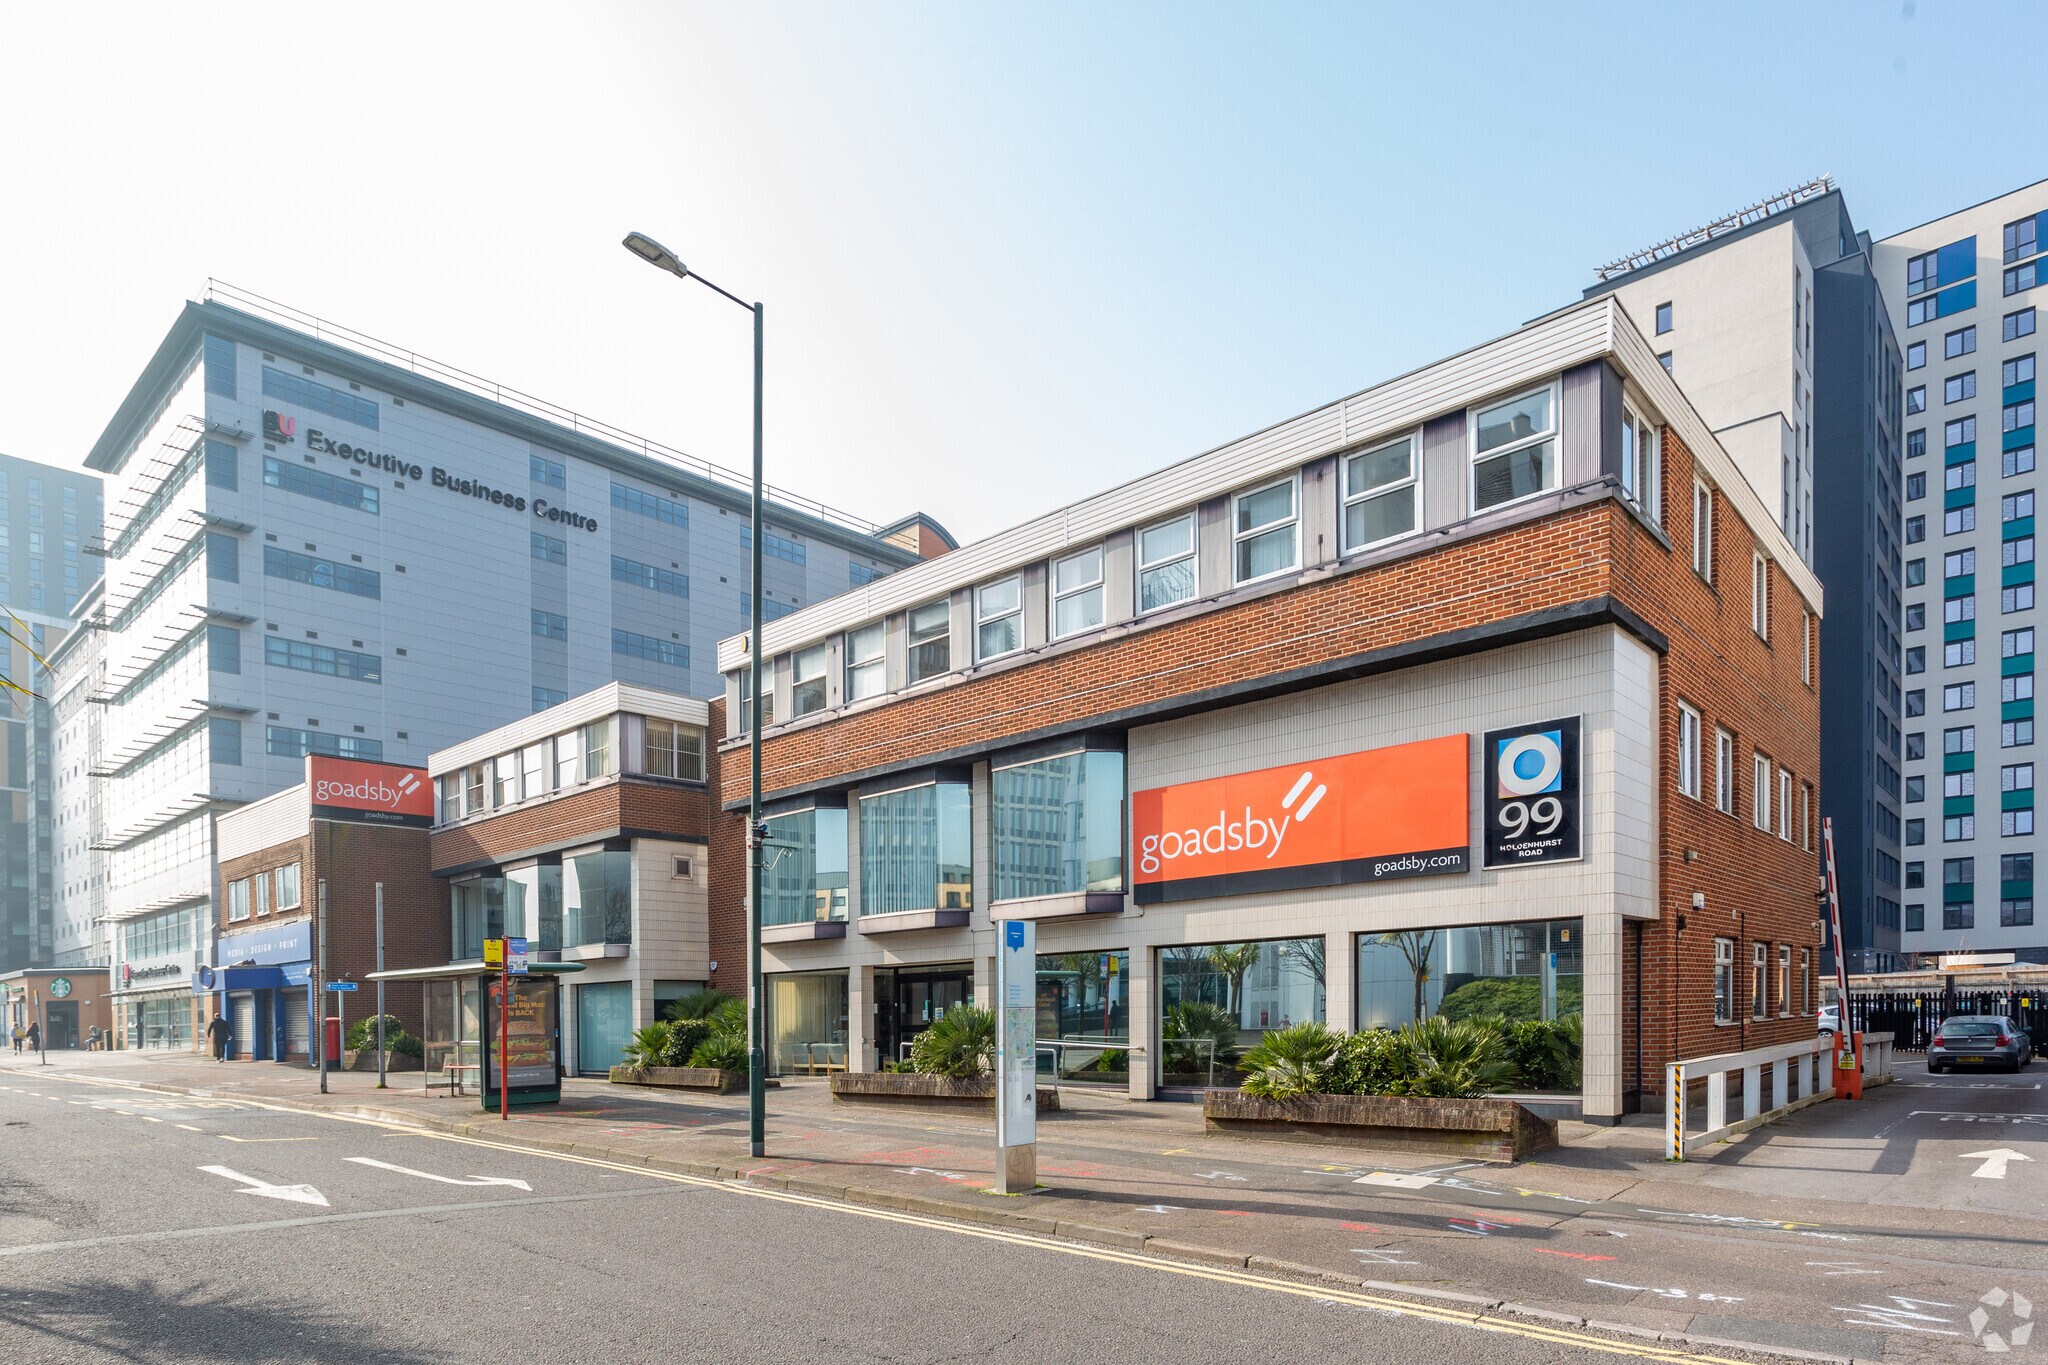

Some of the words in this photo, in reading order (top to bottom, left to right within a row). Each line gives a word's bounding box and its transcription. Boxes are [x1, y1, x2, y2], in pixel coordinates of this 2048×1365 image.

[307, 428, 423, 480] Executive
[432, 466, 526, 511] Business
[533, 498, 598, 533] Centre
[315, 779, 403, 808] goadsby
[364, 811, 404, 822] goadsby.com
[1498, 796, 1563, 839] 99
[1140, 806, 1291, 875] goadsby
[1518, 848, 1543, 857] ROAD
[1374, 853, 1461, 876] goadsby.com
[227, 948, 244, 958] MEDIA
[250, 943, 272, 954] DESIGN
[279, 939, 298, 950] PRINT
